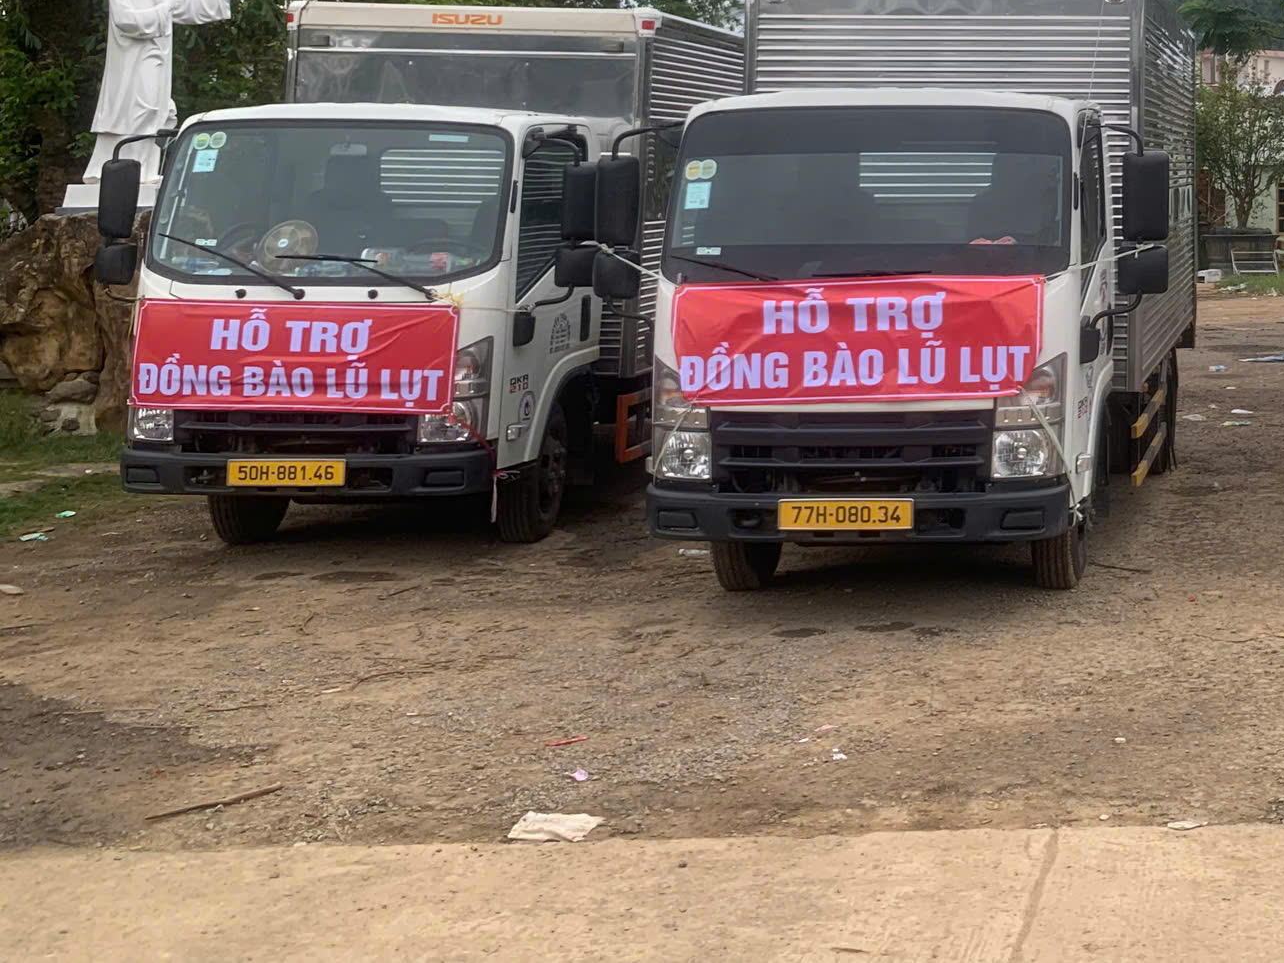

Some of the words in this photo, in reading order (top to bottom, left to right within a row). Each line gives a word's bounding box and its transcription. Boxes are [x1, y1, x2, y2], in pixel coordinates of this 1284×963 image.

[431, 13, 504, 26] ISUZU
[210, 308, 270, 352] HỖ
[286, 318, 373, 360] TRỢ
[762, 287, 829, 335] HỖ
[845, 291, 946, 338] TRỢ
[138, 352, 232, 396] ĐỒNG
[242, 359, 314, 398] BÀO
[326, 361, 369, 399] LŨ
[380, 368, 444, 407] LỤT
[679, 342, 789, 392] ĐỒNG
[803, 341, 884, 387] BÀO
[897, 339, 946, 385] LŨ
[959, 345, 1030, 390] LỤT
[238, 465, 335, 481] 50H-881.46
[791, 505, 901, 524] 77H-080.34
